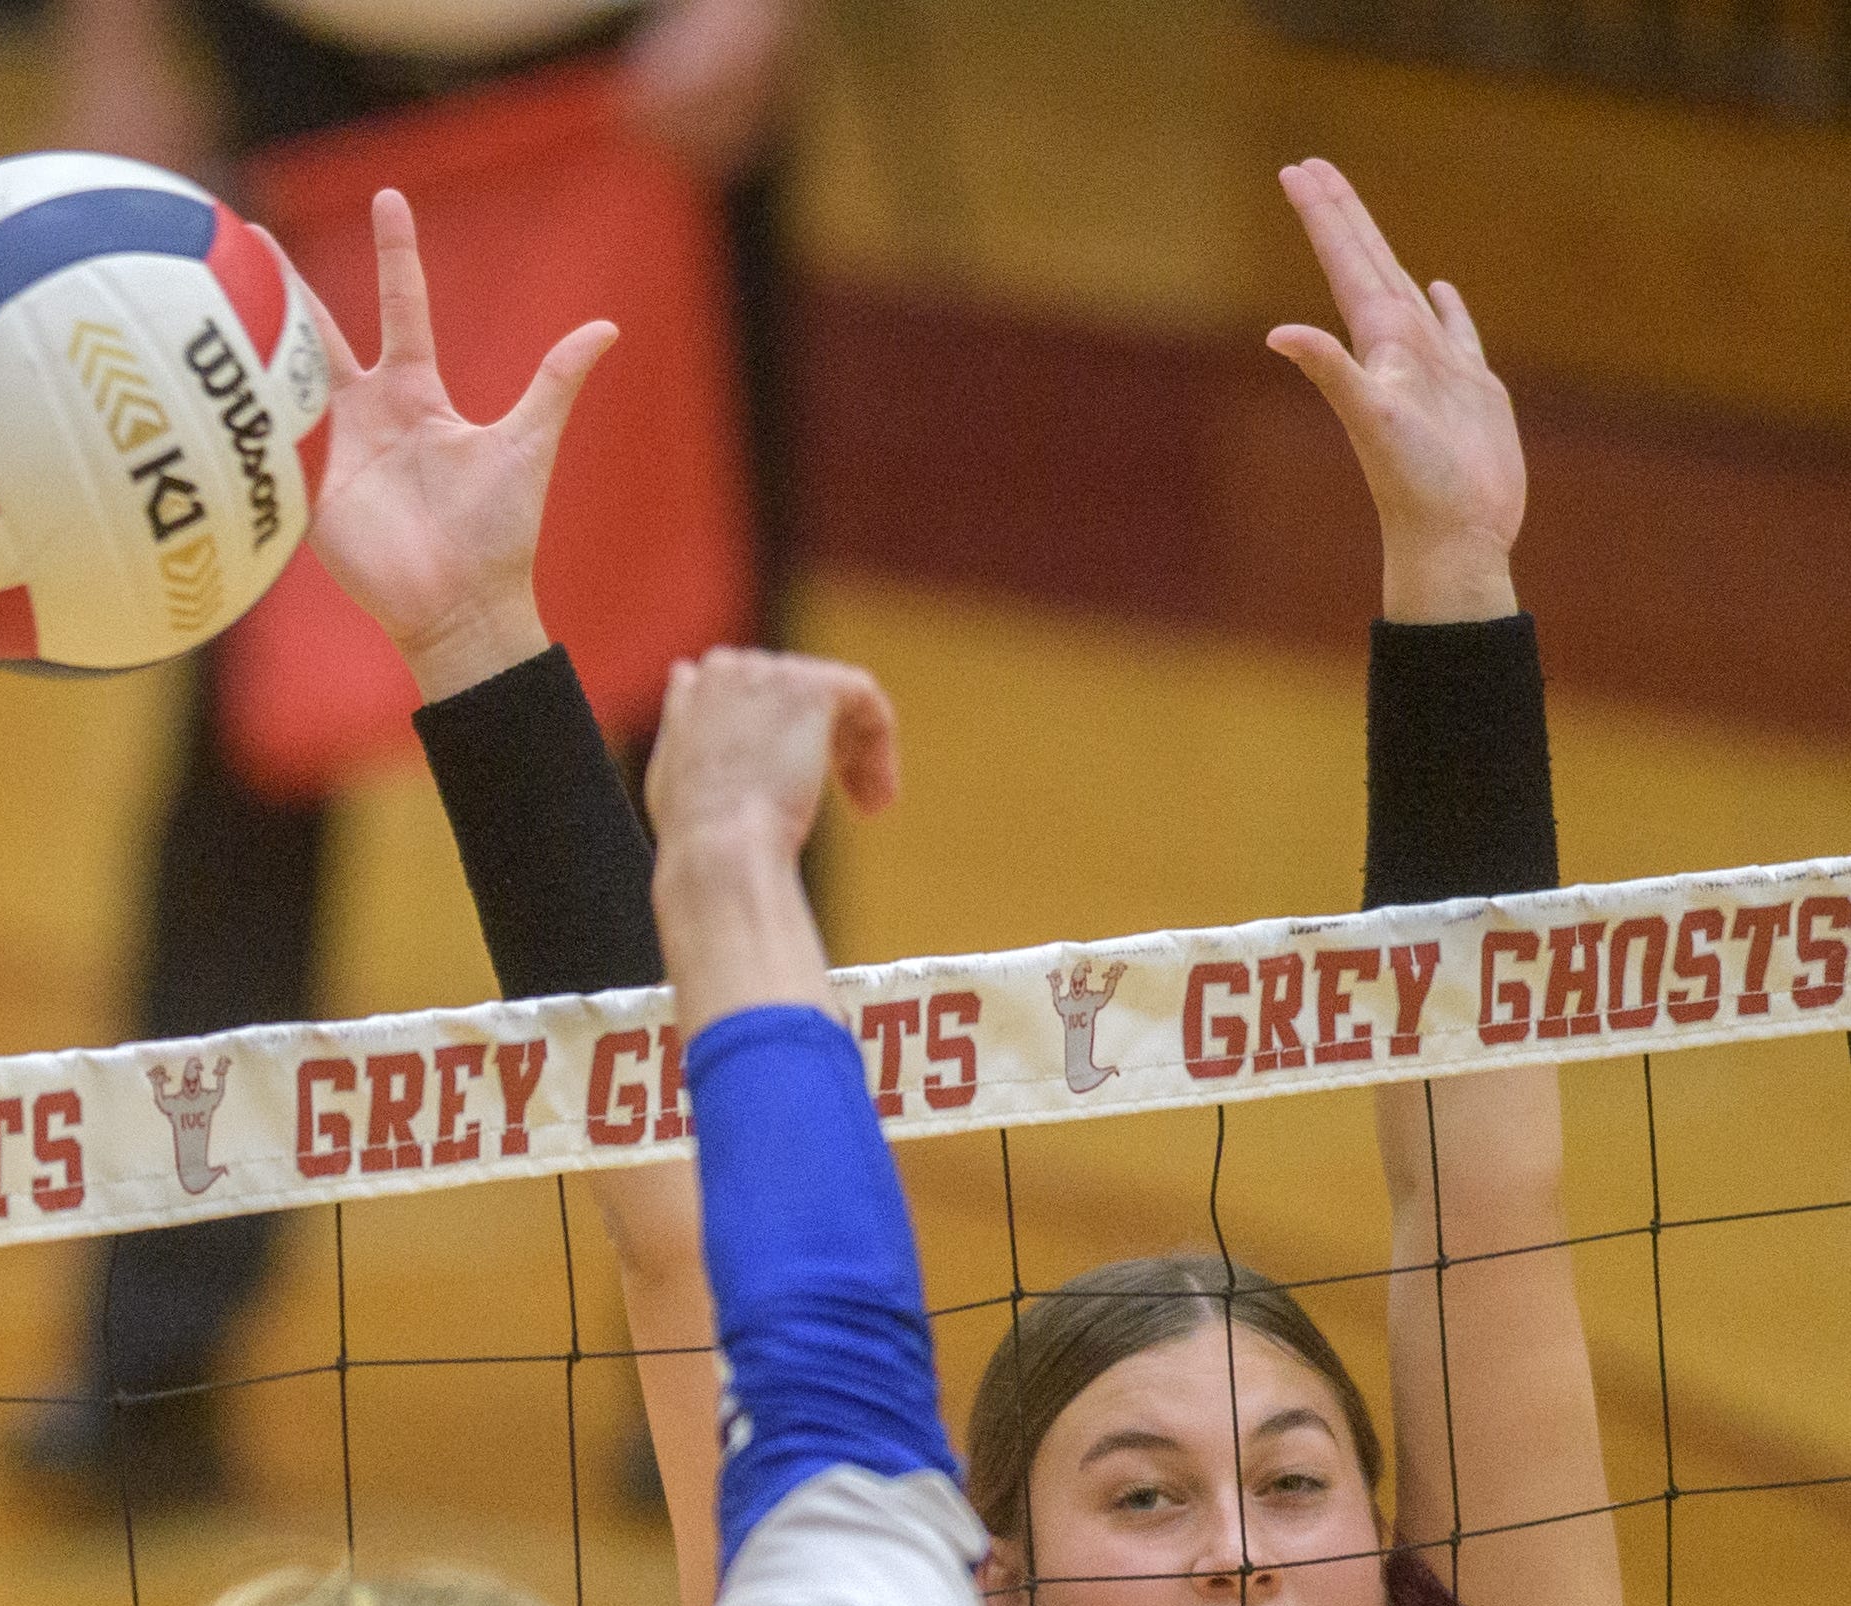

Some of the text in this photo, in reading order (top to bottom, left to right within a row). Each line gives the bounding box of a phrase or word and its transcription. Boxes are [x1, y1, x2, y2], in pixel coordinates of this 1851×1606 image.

[184, 317, 280, 551] Wilson
[1182, 896, 1851, 1081] GREY GHOSTS
[296, 1038, 547, 1179] GREY
